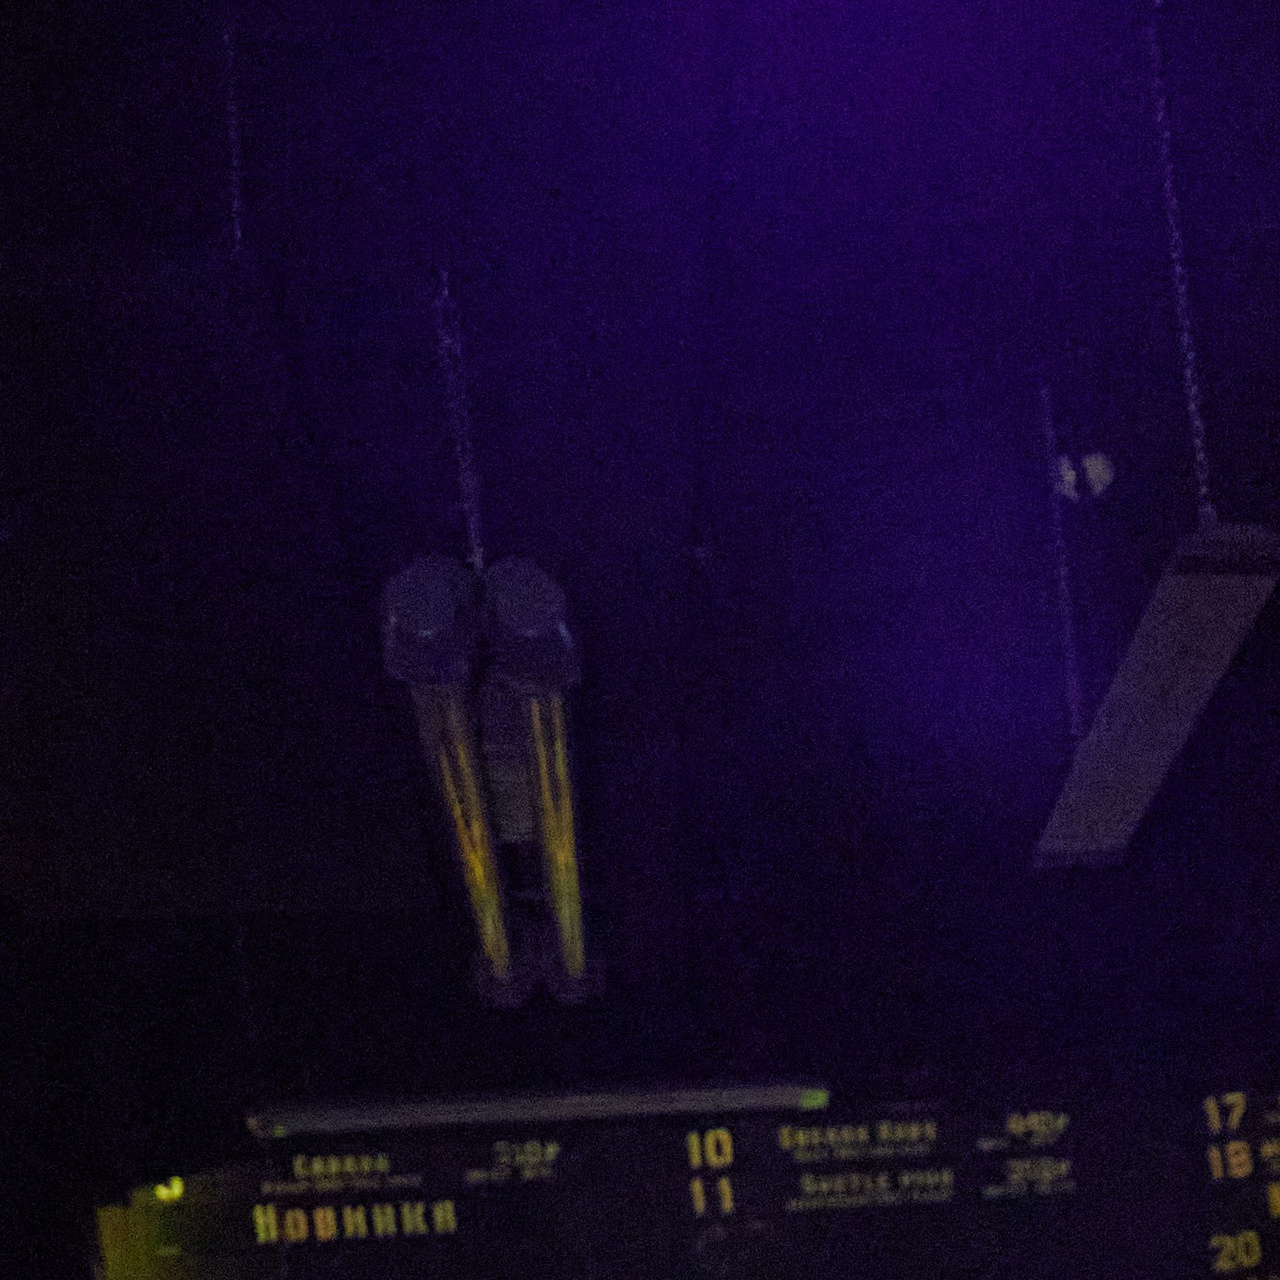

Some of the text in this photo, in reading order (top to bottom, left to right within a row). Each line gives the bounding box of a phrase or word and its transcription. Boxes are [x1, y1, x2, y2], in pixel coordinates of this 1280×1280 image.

[1203, 1090, 1247, 1134] 17
[687, 1128, 734, 1169] 10
[1207, 1140, 1253, 1180] 18
[691, 1176, 734, 1216] 11
[1209, 1230, 1262, 1273] 20
